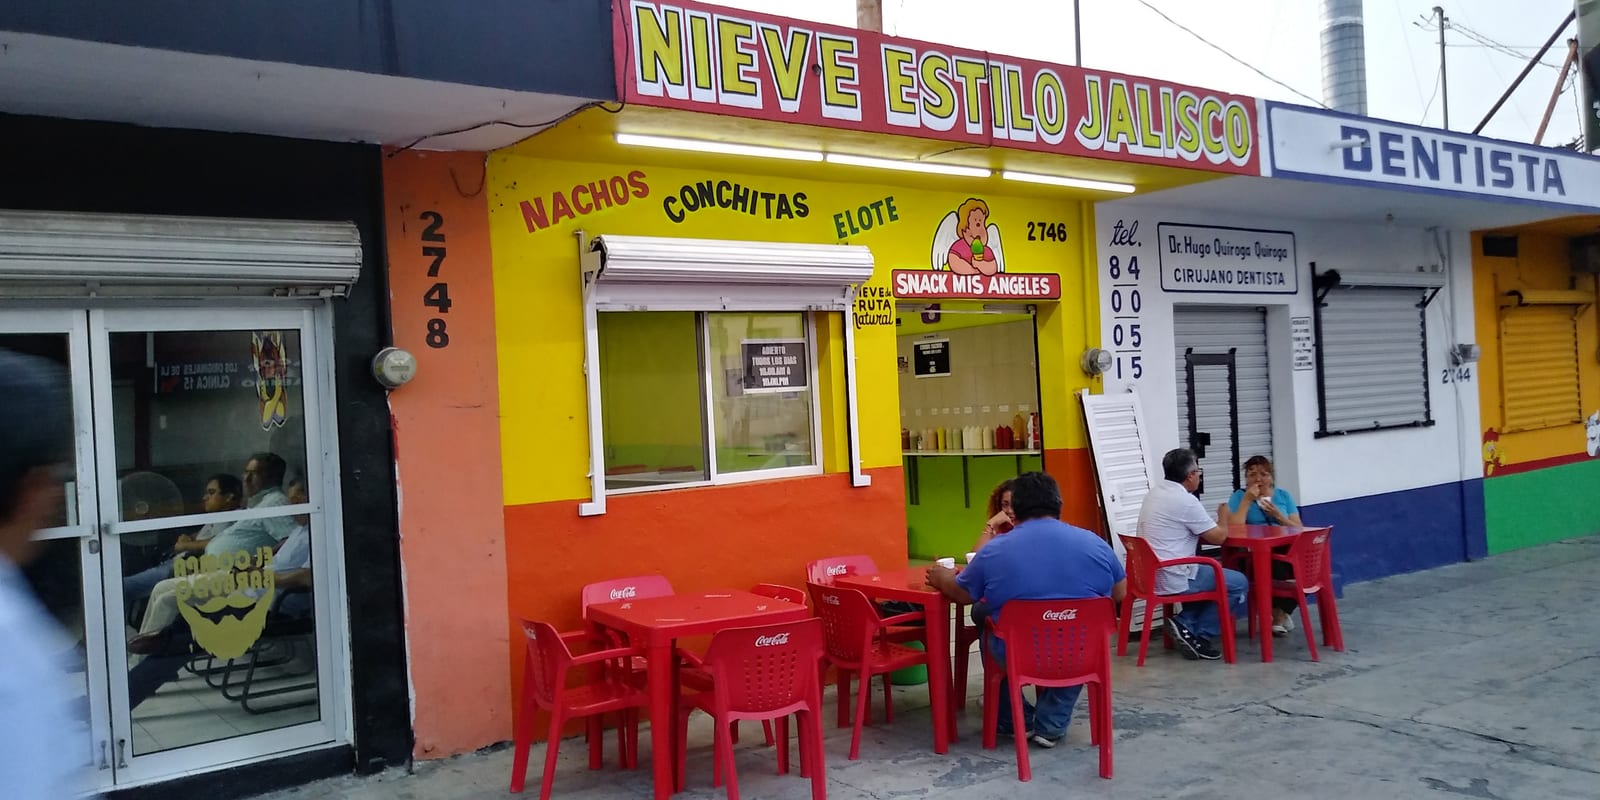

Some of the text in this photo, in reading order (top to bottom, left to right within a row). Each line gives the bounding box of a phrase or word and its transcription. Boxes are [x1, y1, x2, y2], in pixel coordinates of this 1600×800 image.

[631, 1, 1251, 166] NIEVE ESTILO JALISCO
[1340, 125, 1566, 196] DENTISTA
[519, 170, 650, 233] NACHOS
[663, 180, 810, 223] CONCHITAS
[833, 196, 899, 239] ELOTE
[1027, 222, 1067, 242] 2746
[1109, 219, 1142, 248] tel.
[1168, 234, 1288, 262] Dr. Hugo Quiroga Quiroga
[419, 211, 452, 349] 2748
[852, 286, 884, 298] IEVE
[896, 273, 1050, 296] SNACK MIS ANGELES
[1173, 268, 1286, 286] CIRUJANO DENTISTA
